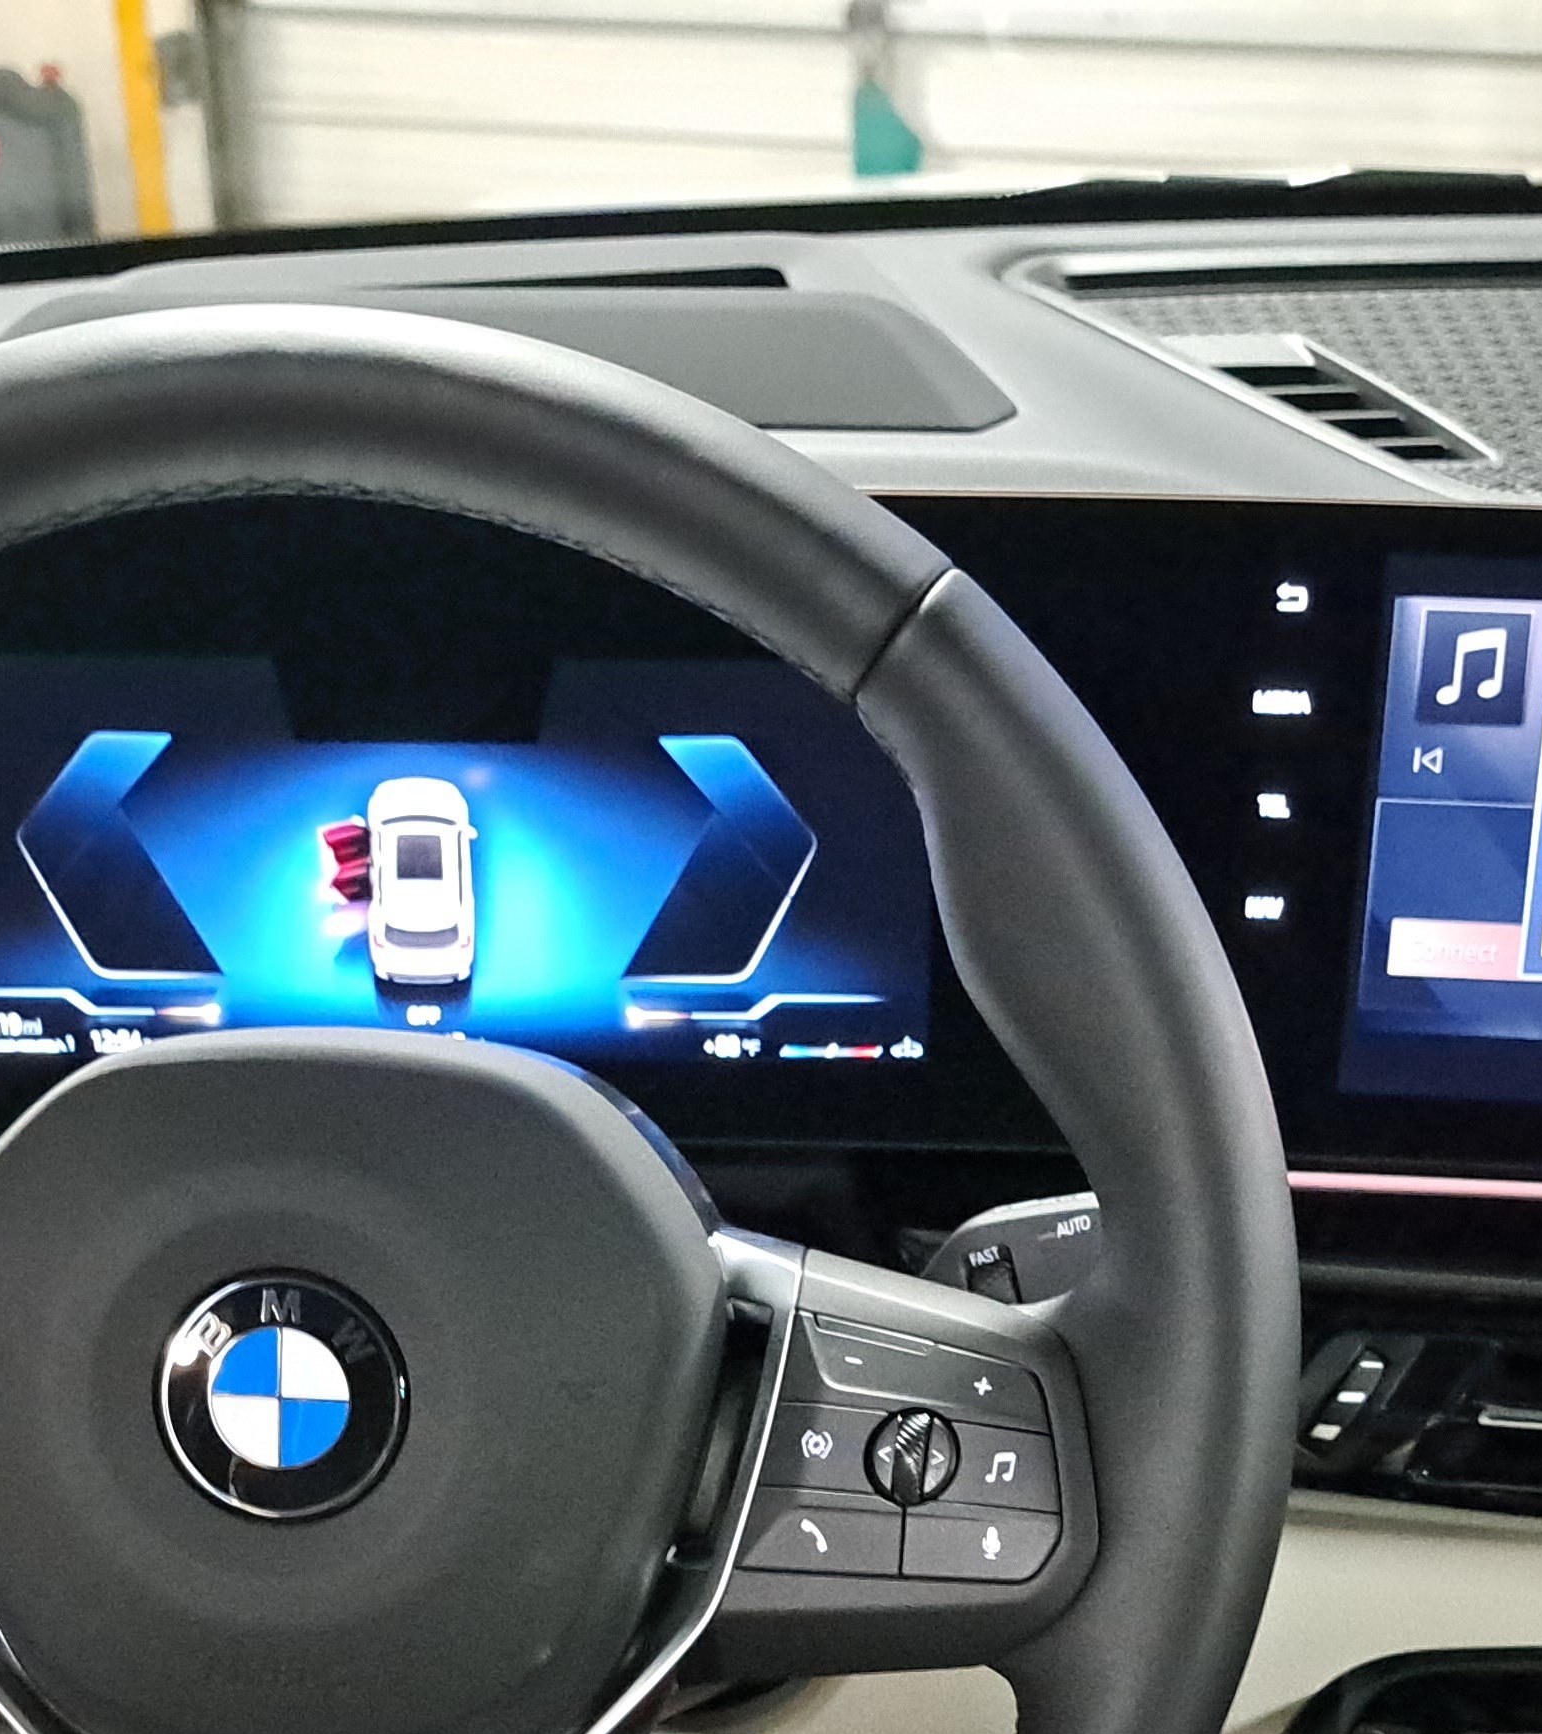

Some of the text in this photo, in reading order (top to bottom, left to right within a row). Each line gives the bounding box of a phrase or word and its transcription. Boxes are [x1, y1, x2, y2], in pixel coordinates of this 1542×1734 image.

[1056, 1214, 1091, 1238] AUTO
[968, 1245, 1000, 1267] FAST
[198, 1286, 378, 1365] BMW
